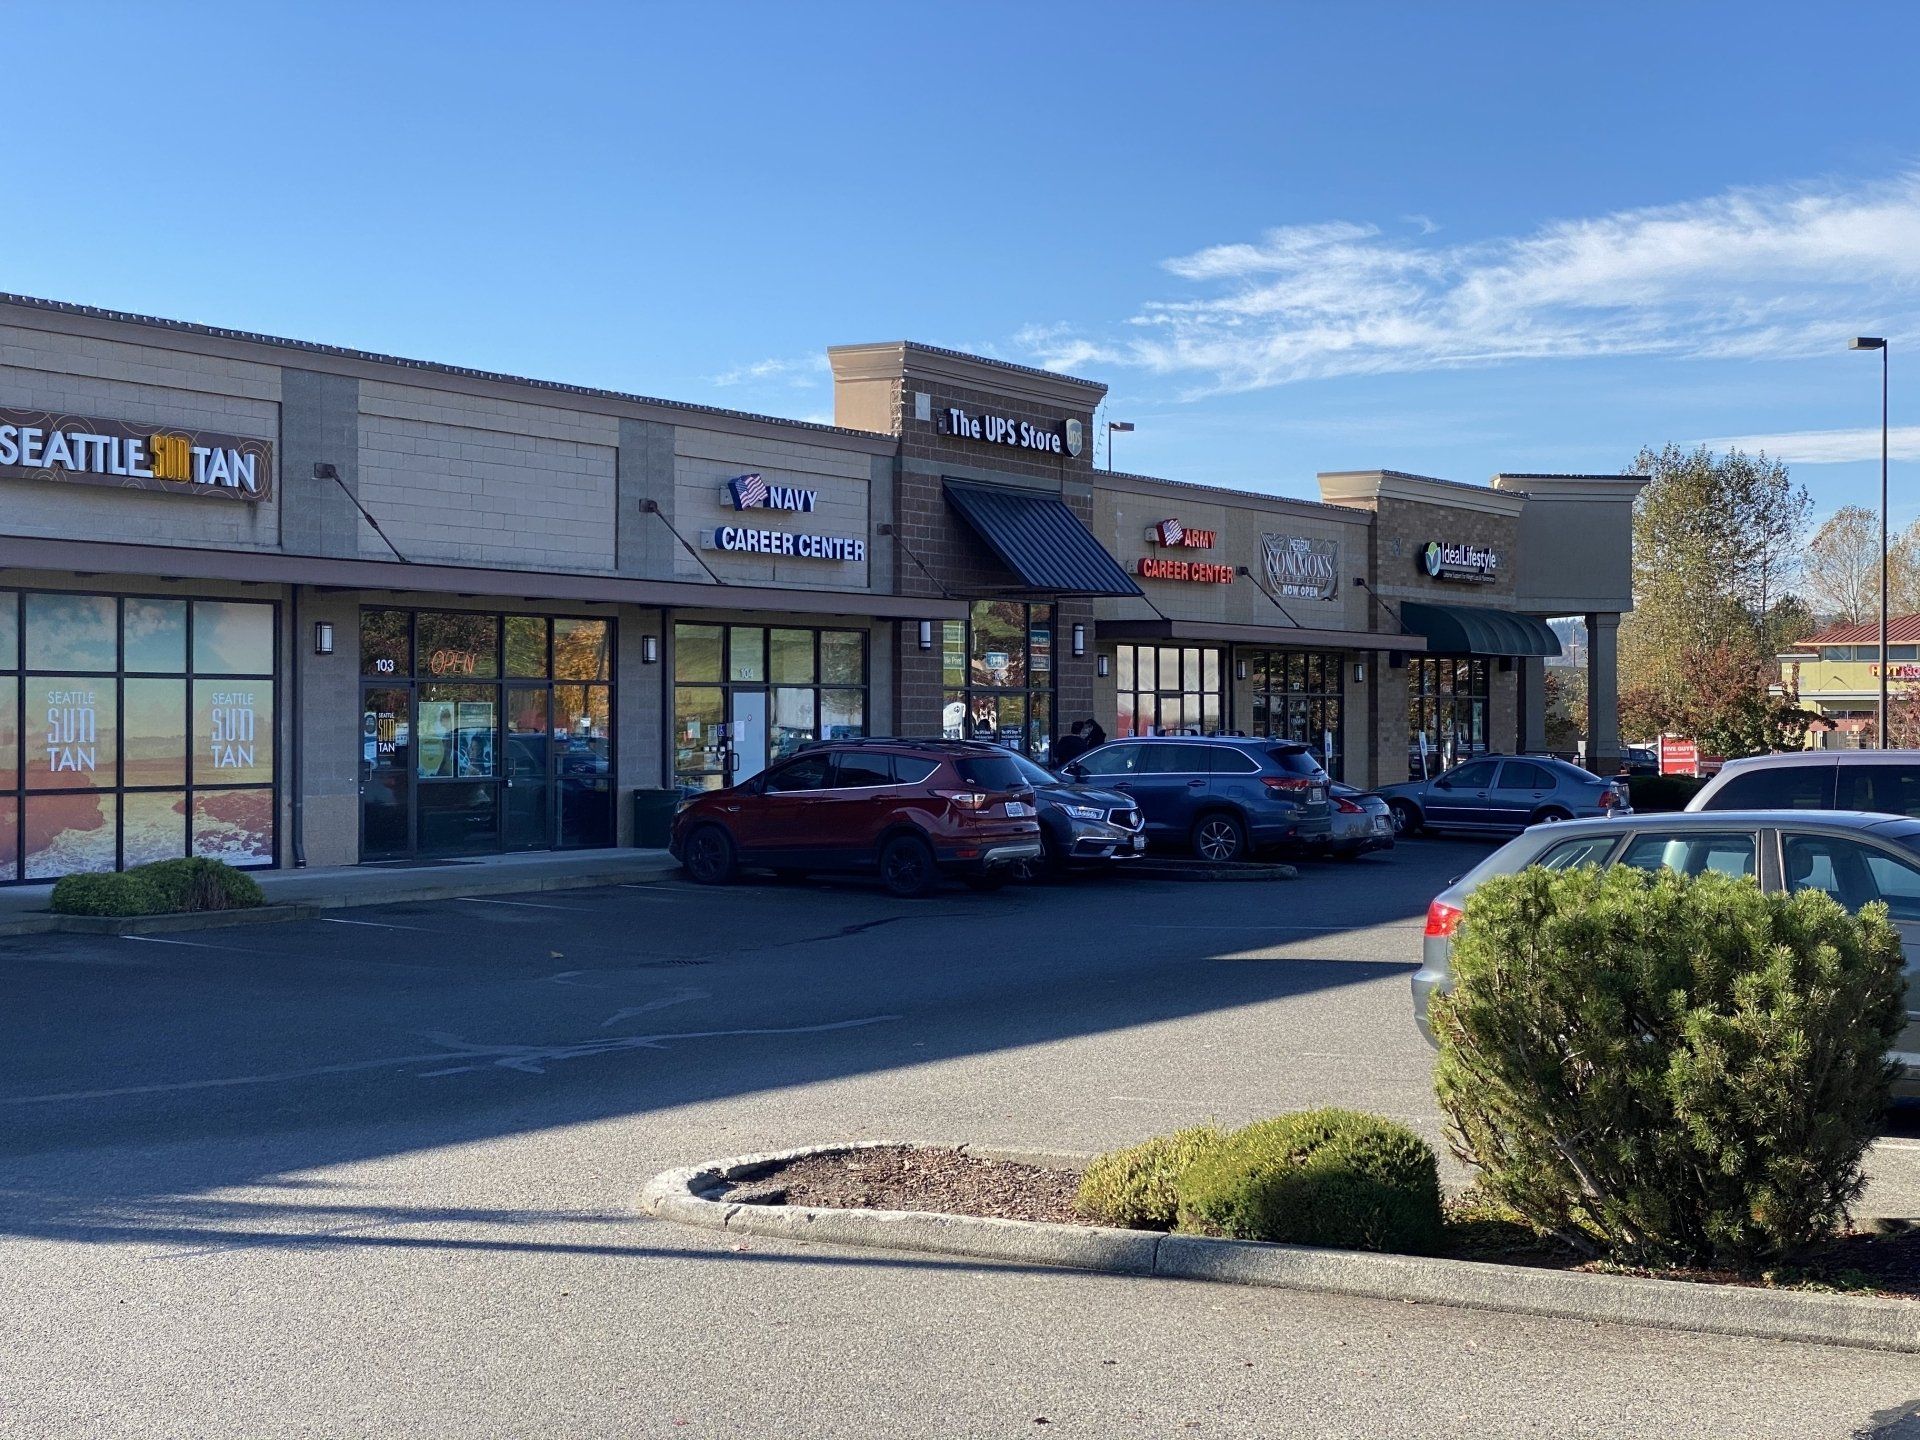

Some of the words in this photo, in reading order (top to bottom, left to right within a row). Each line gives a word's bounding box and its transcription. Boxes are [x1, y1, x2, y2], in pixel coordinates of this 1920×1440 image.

[949, 408, 981, 439] The
[985, 415, 1016, 445] UPS
[1020, 421, 1061, 453] Store
[0, 424, 154, 479] SEATTLE
[191, 446, 257, 493] TAN
[769, 486, 818, 513] NAVY
[720, 526, 794, 555] CAREER
[798, 534, 865, 562] CENTER
[1184, 530, 1217, 549] ARMY
[1441, 542, 1461, 564] Ideal
[1462, 545, 1496, 573] Lifestyle
[1142, 559, 1189, 582] CAREER
[1191, 563, 1235, 585] CENTER
[1282, 585, 1299, 596] NOW
[1300, 586, 1318, 597] OPEN
[375, 659, 394, 672] 103
[430, 650, 477, 674] OPEN
[47, 691, 95, 705] SEATTLE
[211, 693, 254, 705] SEATTLE
[211, 745, 254, 768] TAN
[378, 742, 395, 752] TAN
[47, 747, 95, 772] TAN
